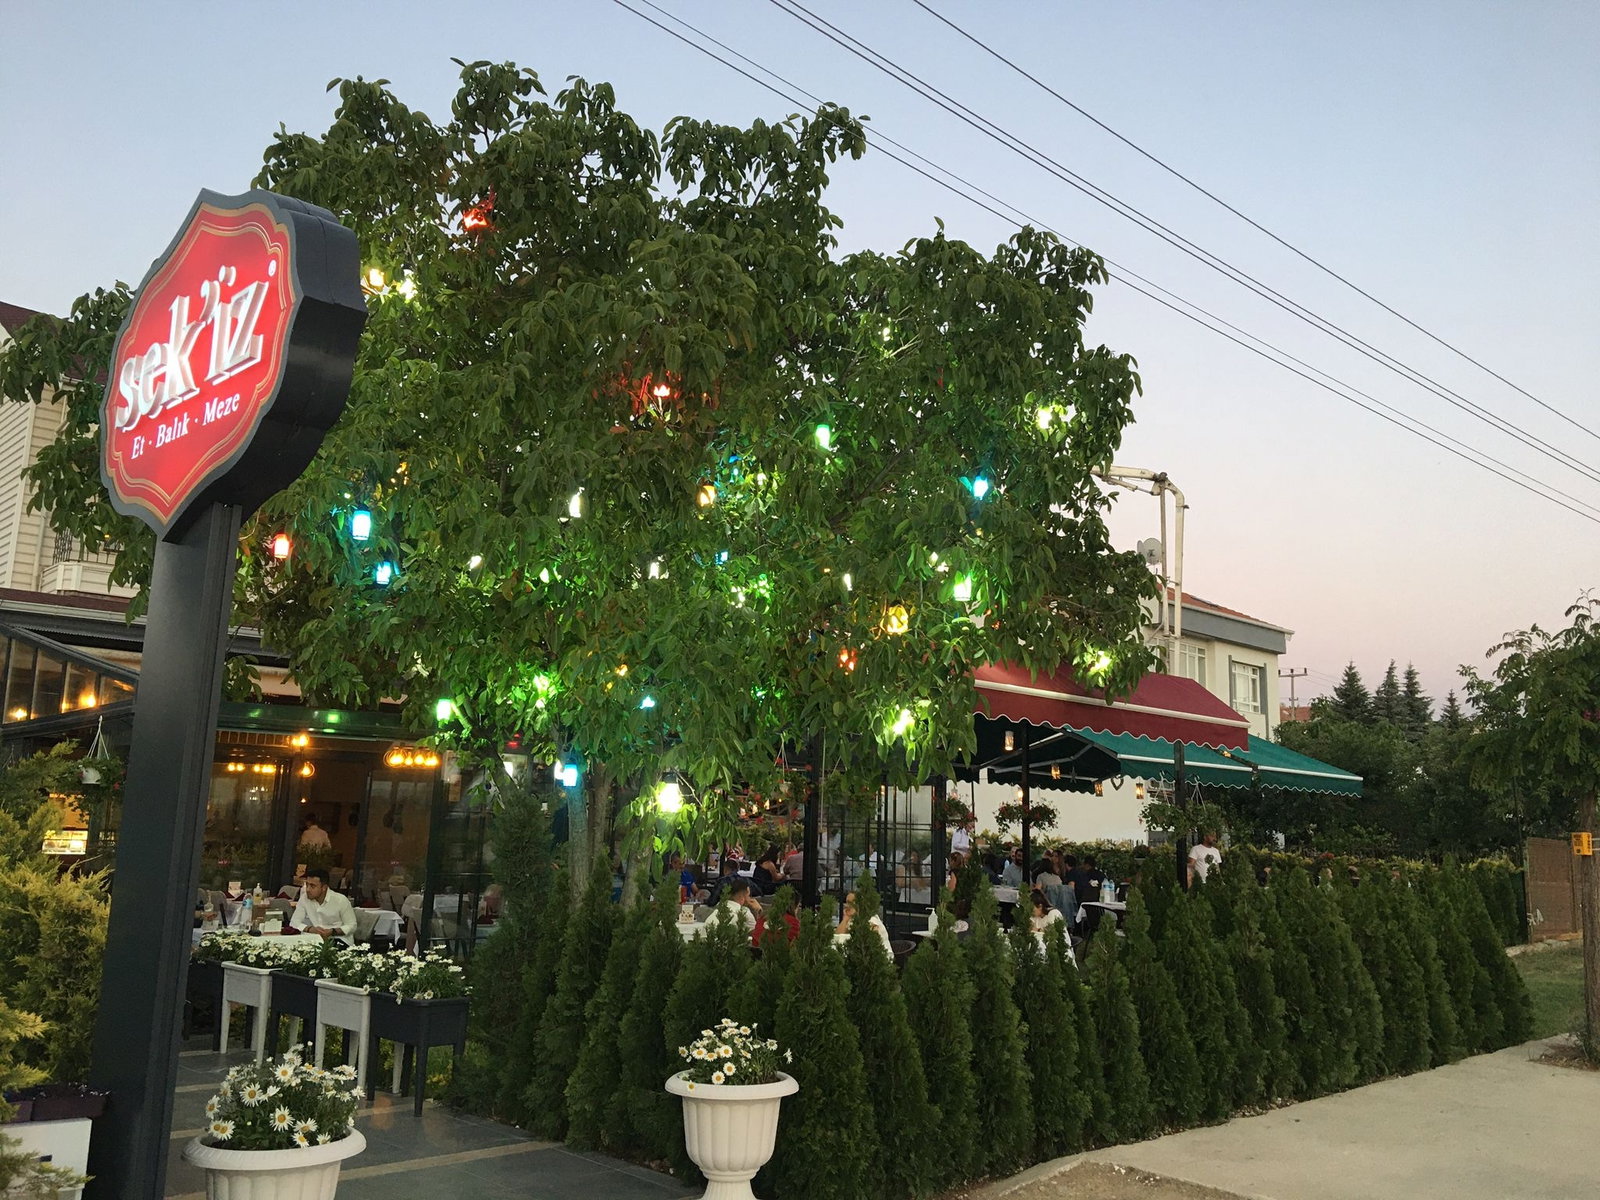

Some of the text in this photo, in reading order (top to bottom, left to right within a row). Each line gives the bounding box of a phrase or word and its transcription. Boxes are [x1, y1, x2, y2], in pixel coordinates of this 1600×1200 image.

[131, 393, 240, 459] Et Balık Meze
